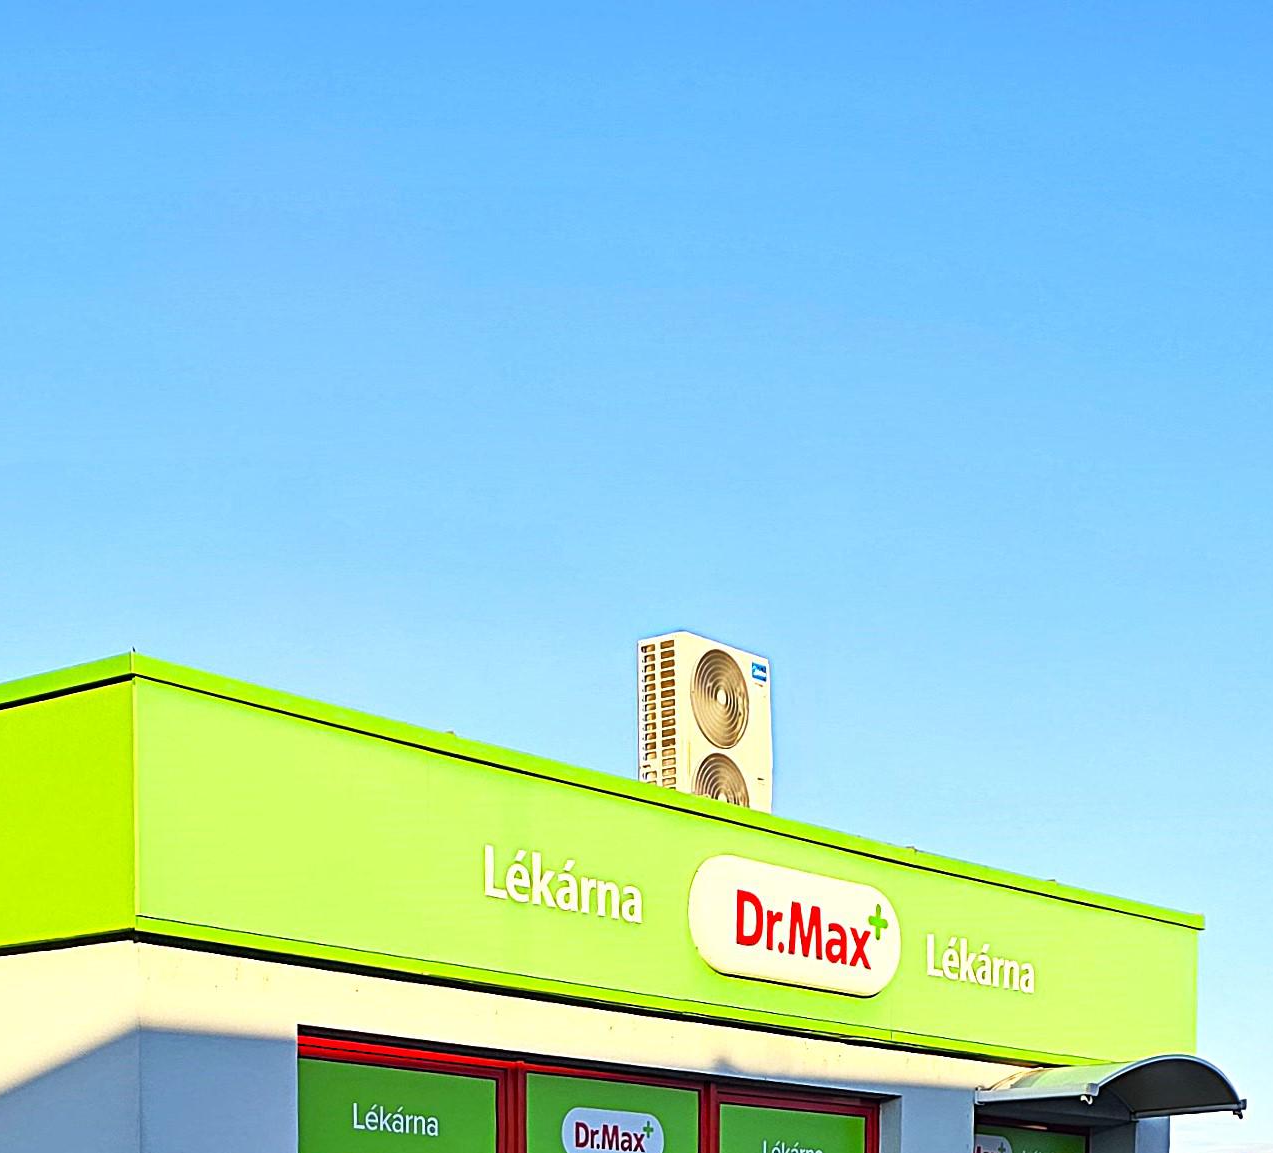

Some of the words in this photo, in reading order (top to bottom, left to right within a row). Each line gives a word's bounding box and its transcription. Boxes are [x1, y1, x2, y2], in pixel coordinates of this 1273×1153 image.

[484, 844, 643, 924] Lékárna
[735, 888, 872, 970] Dr.Max
[926, 933, 1036, 995] Lékárna
[352, 1101, 439, 1138] Lékárna
[574, 1121, 646, 1153] Dr.Max
